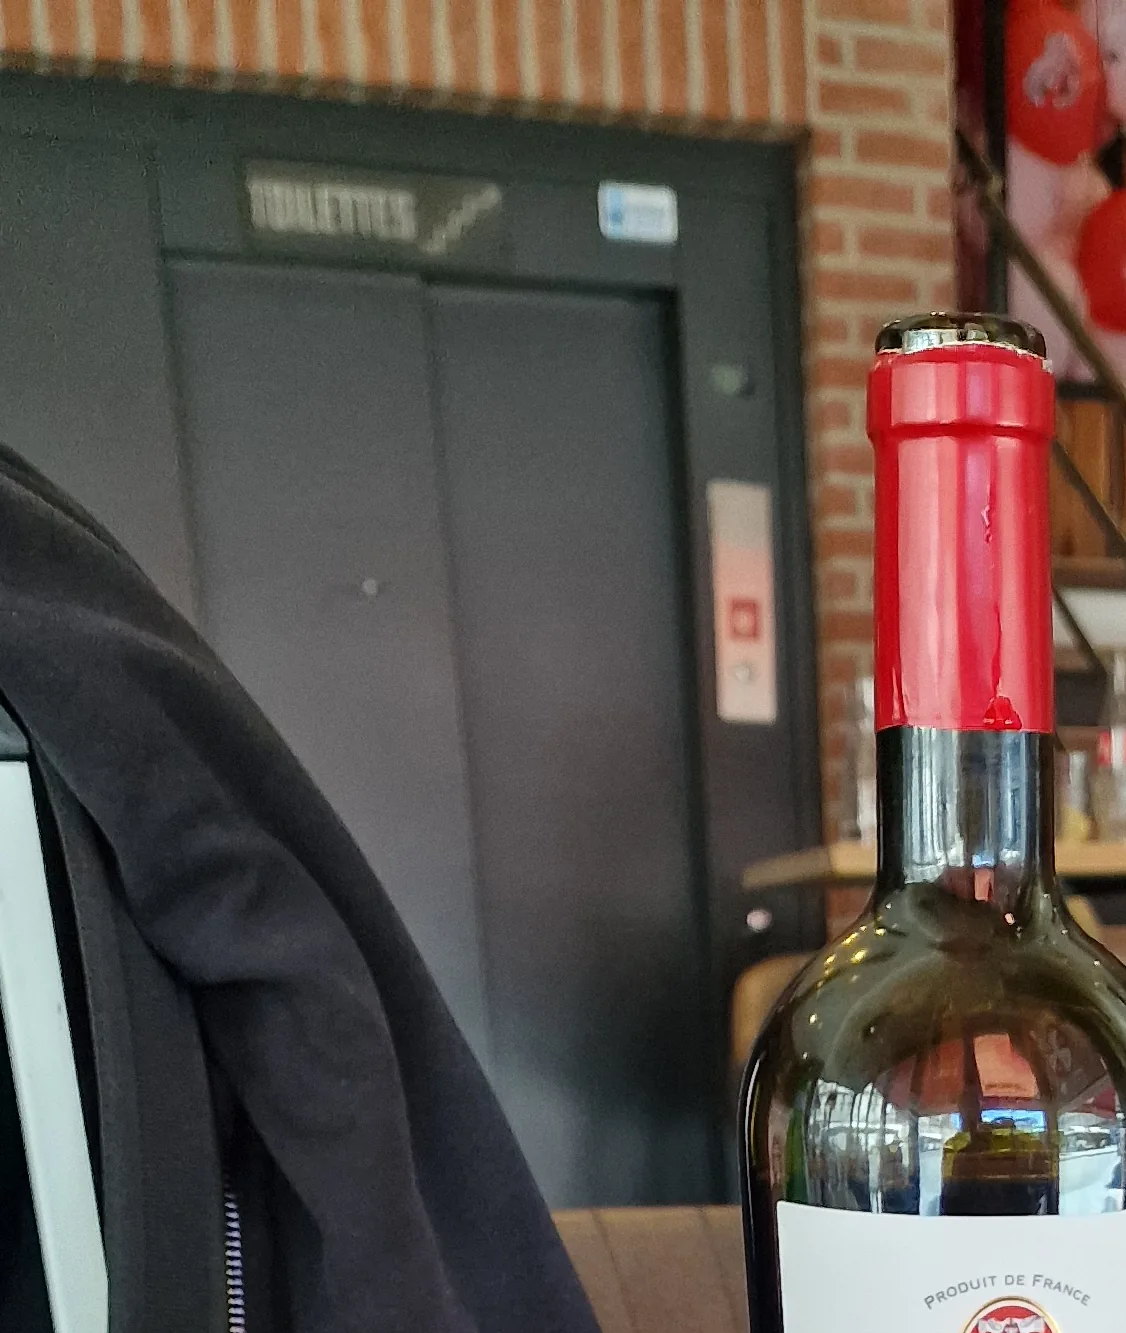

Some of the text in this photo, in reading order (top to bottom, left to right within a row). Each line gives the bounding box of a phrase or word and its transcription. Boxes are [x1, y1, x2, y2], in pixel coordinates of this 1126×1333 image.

[924, 1273, 1092, 1310] PRODUIT DE FRANCE
